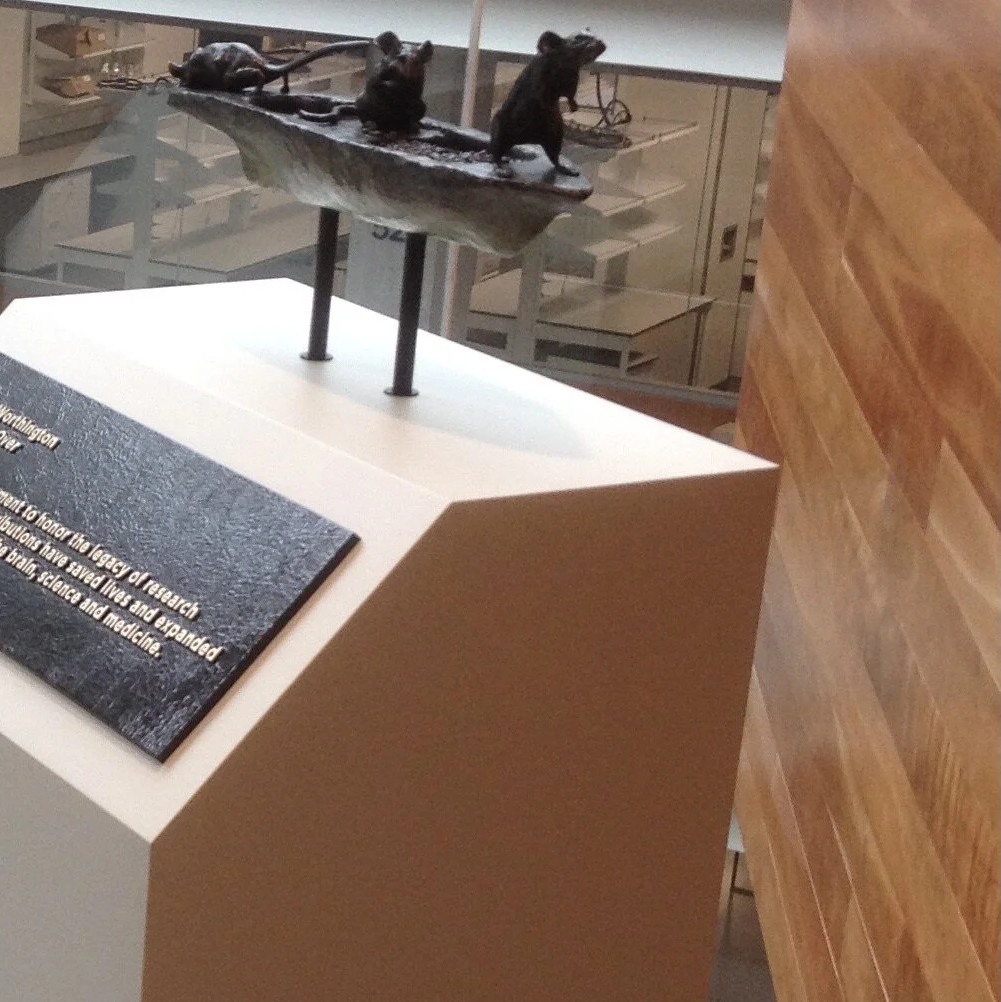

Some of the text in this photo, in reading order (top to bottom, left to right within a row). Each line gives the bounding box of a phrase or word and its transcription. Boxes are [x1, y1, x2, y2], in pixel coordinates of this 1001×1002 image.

[5, 548, 38, 579] brain,
[37, 571, 81, 600] science
[78, 598, 109, 619] and
[102, 612, 161, 658] medicine.
[22, 505, 38, 520] to
[34, 513, 71, 541] honor
[68, 532, 91, 553] the
[88, 544, 131, 578] legacy
[128, 571, 150, 586] of
[142, 580, 199, 619] research
[39, 542, 68, 567] have
[65, 561, 105, 589] saved
[100, 579, 132, 607] lives
[129, 600, 159, 622] and
[154, 616, 222, 662] expanded
